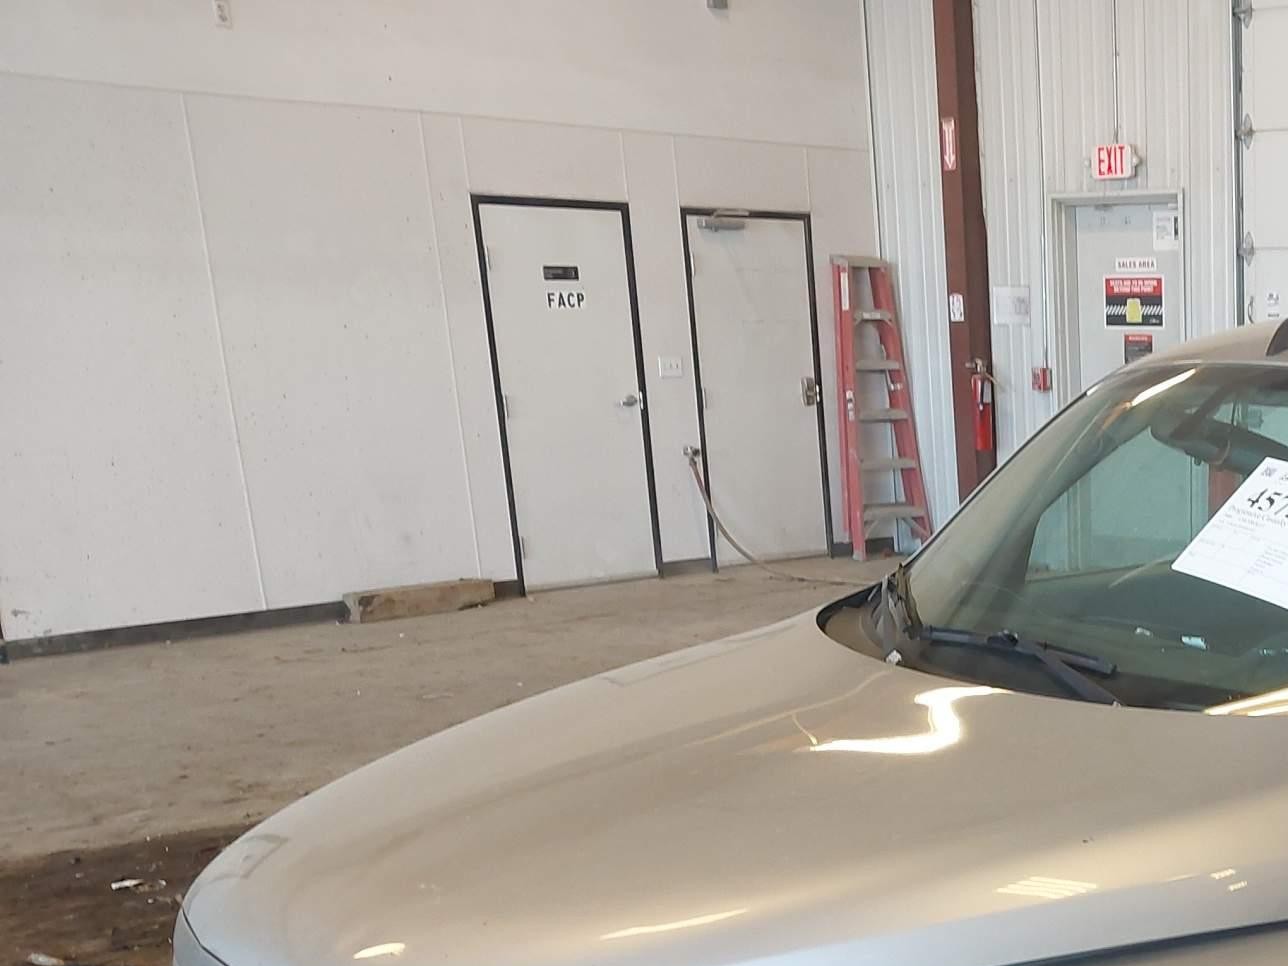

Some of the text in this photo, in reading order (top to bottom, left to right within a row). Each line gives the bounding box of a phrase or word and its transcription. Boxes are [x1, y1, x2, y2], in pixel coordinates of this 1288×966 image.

[1098, 145, 1125, 175] EXIT
[1118, 260, 1154, 269] SALES AREA
[547, 292, 585, 309] FACP
